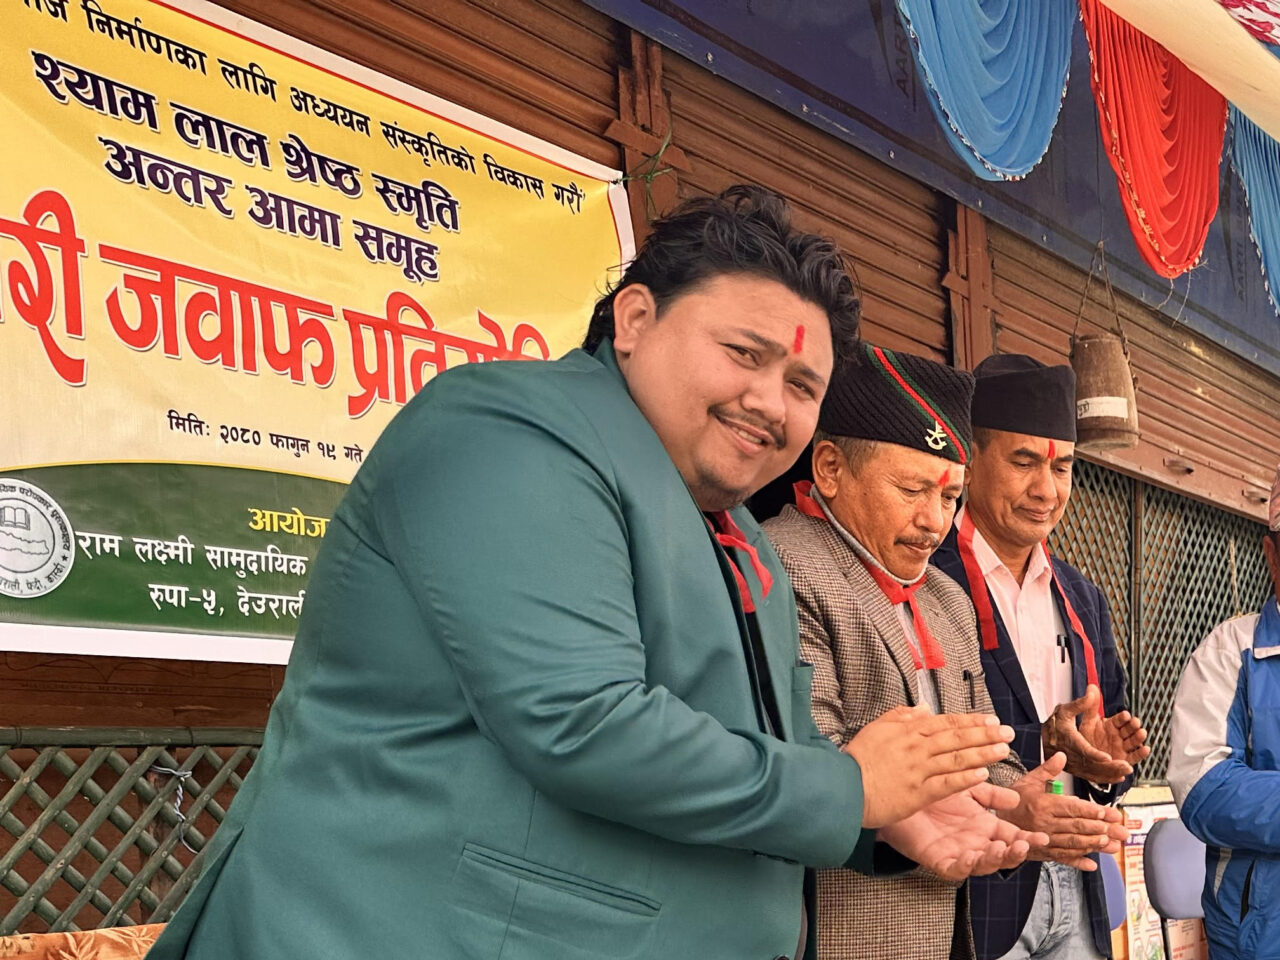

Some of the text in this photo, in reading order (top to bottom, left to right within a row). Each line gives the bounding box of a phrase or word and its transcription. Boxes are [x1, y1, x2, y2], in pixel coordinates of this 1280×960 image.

[31, 50, 459, 231] श्याम लाल श्रेष्ठ स्मृति
[217, 58, 277, 102] लागि
[290, 86, 371, 137] अध्ययन
[380, 121, 476, 174] संस्कृतिको
[483, 153, 544, 200] विकास
[97, 136, 439, 282] अन्तर आमा समूह
[0, 190, 87, 384] री
[98, 243, 336, 386] जवाफ
[220, 424, 261, 446] २०८०
[269, 432, 310, 457] फागुन
[317, 442, 336, 460] १९
[343, 443, 363, 463] गते
[75, 531, 309, 578] राम लक्ष्मी सामुदायिक
[247, 507, 331, 538] आयोज
